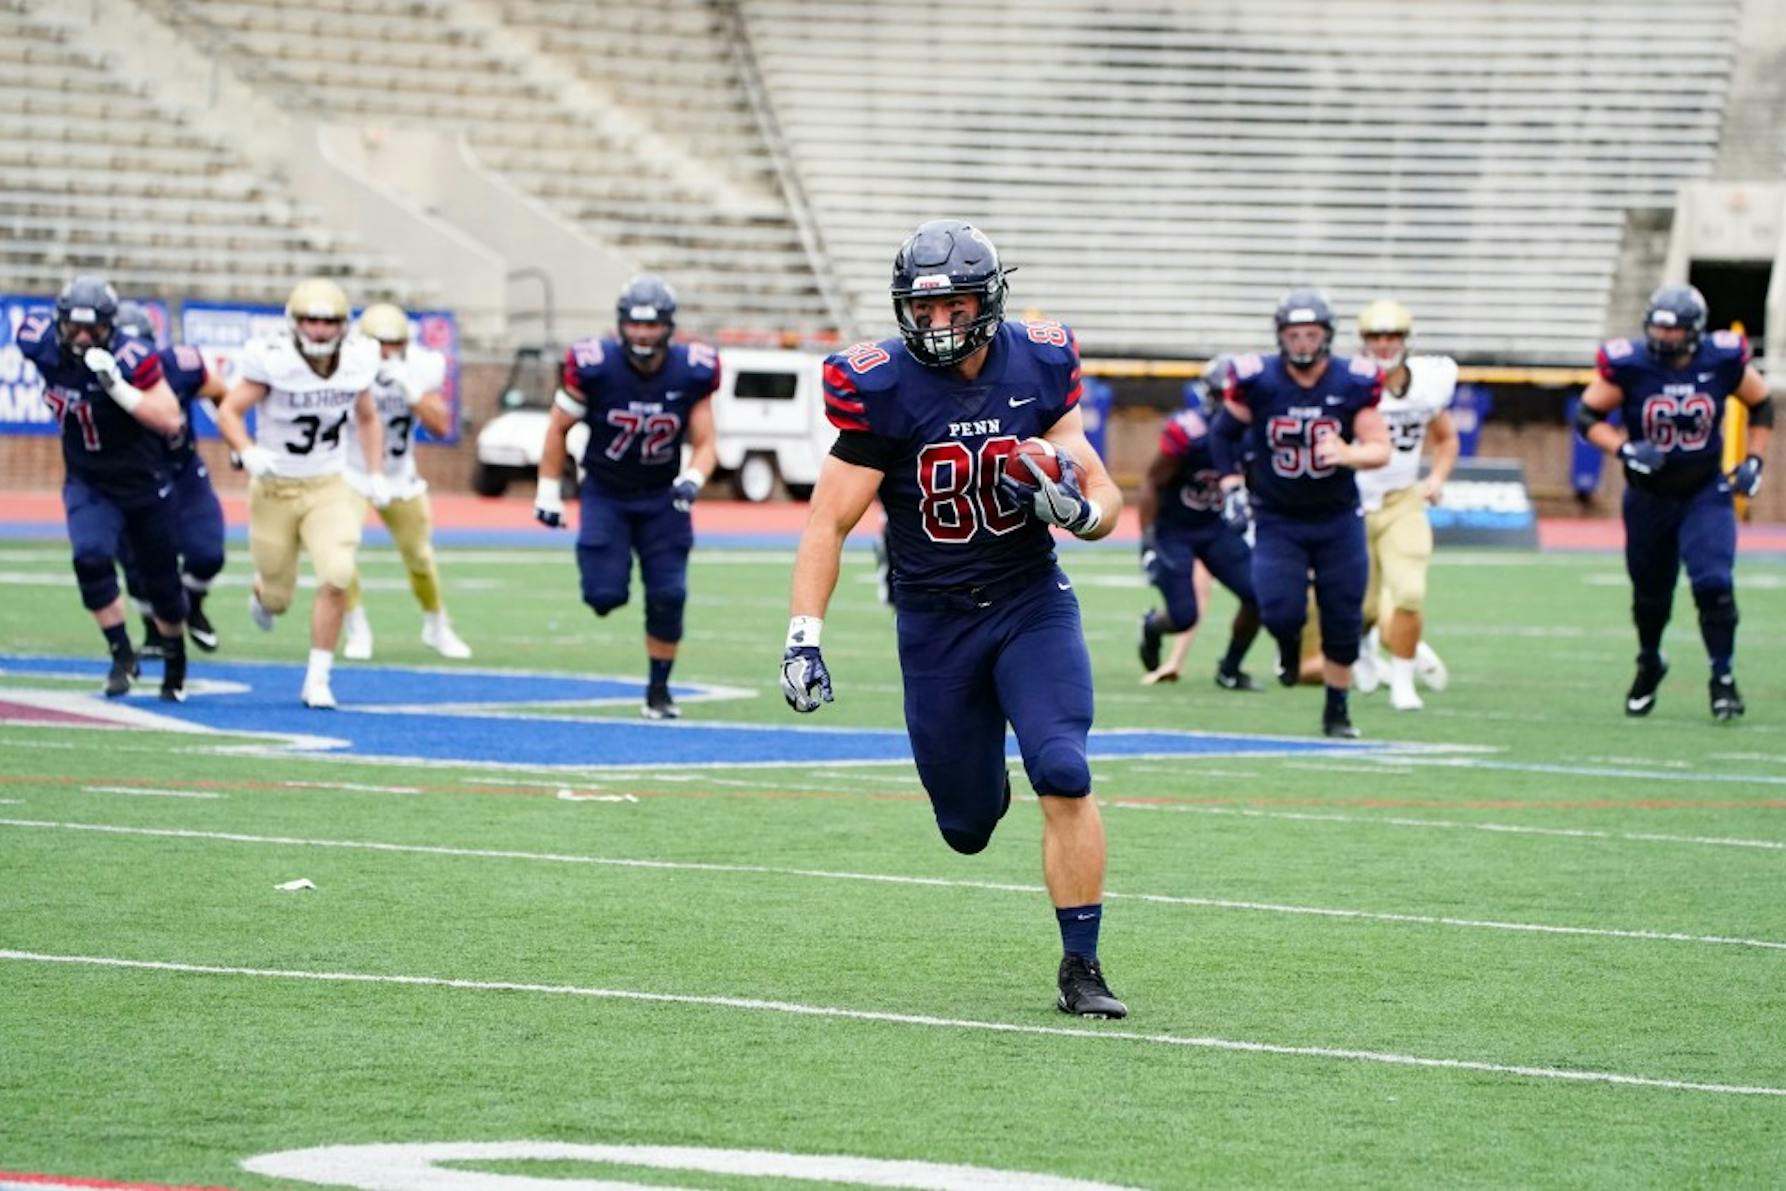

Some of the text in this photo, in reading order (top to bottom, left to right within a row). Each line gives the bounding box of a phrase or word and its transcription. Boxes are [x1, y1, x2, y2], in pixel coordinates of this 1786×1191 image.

[42, 388, 102, 451] 71
[285, 411, 348, 457] 34
[605, 409, 682, 465] 72
[949, 419, 999, 437] PENN
[1642, 393, 1715, 453] 63
[917, 435, 1028, 544] 80
